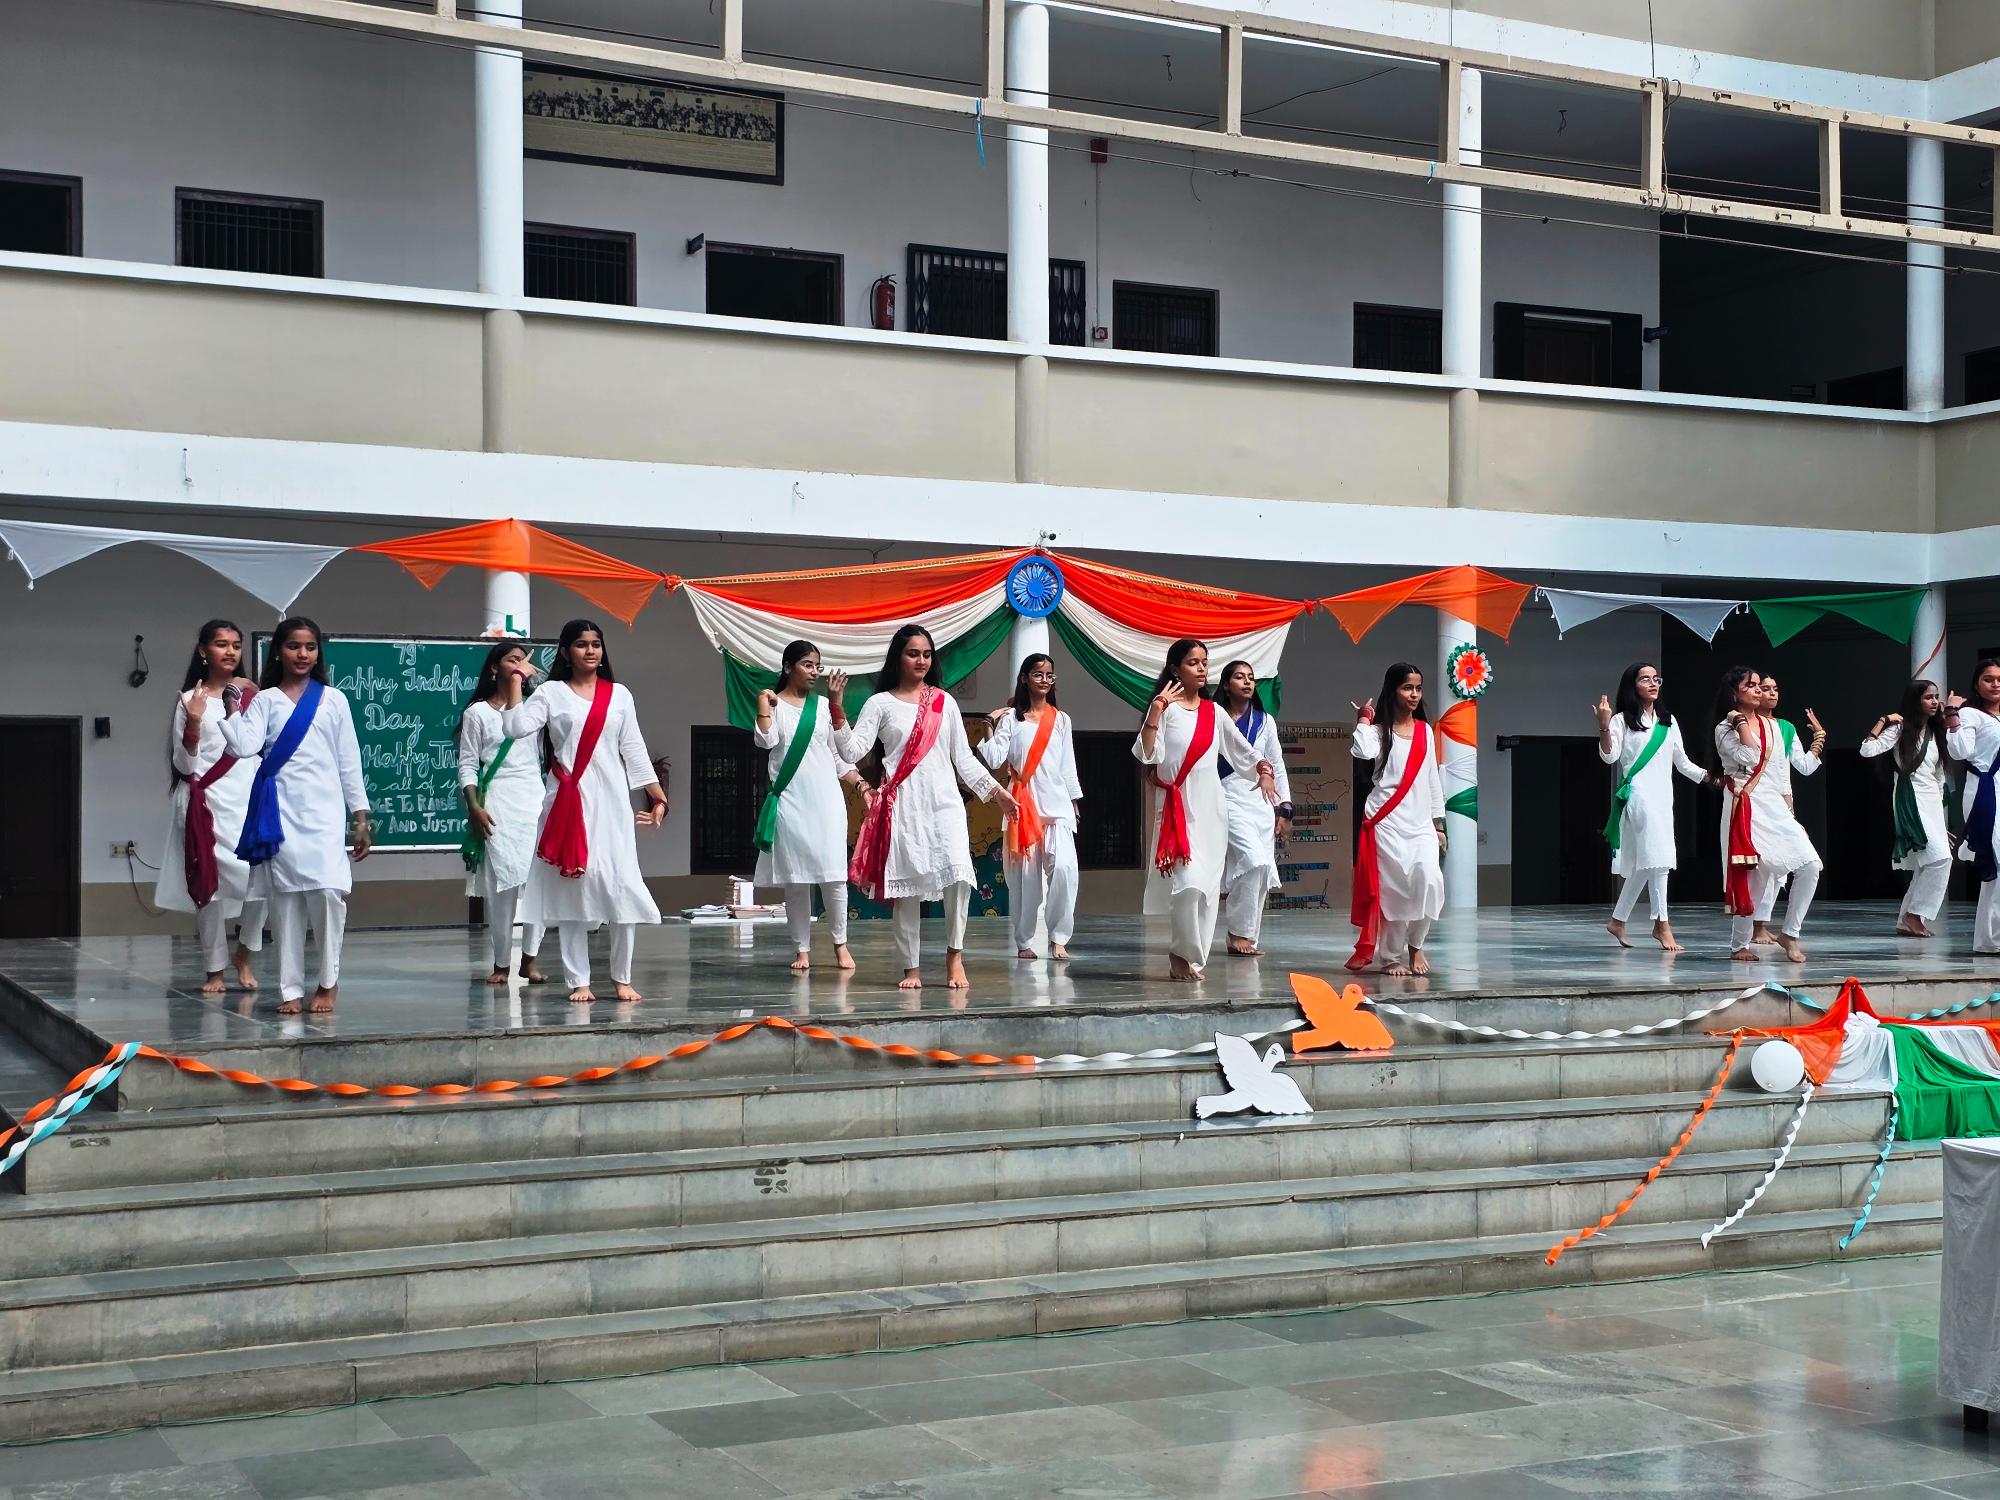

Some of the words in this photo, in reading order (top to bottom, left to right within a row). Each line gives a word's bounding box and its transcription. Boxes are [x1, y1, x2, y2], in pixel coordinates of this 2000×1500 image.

[364, 702, 425, 749] Day
[380, 776, 413, 791] all
[415, 773, 435, 797] of
[416, 793, 458, 812] RAISE
[388, 814, 418, 834] AND
